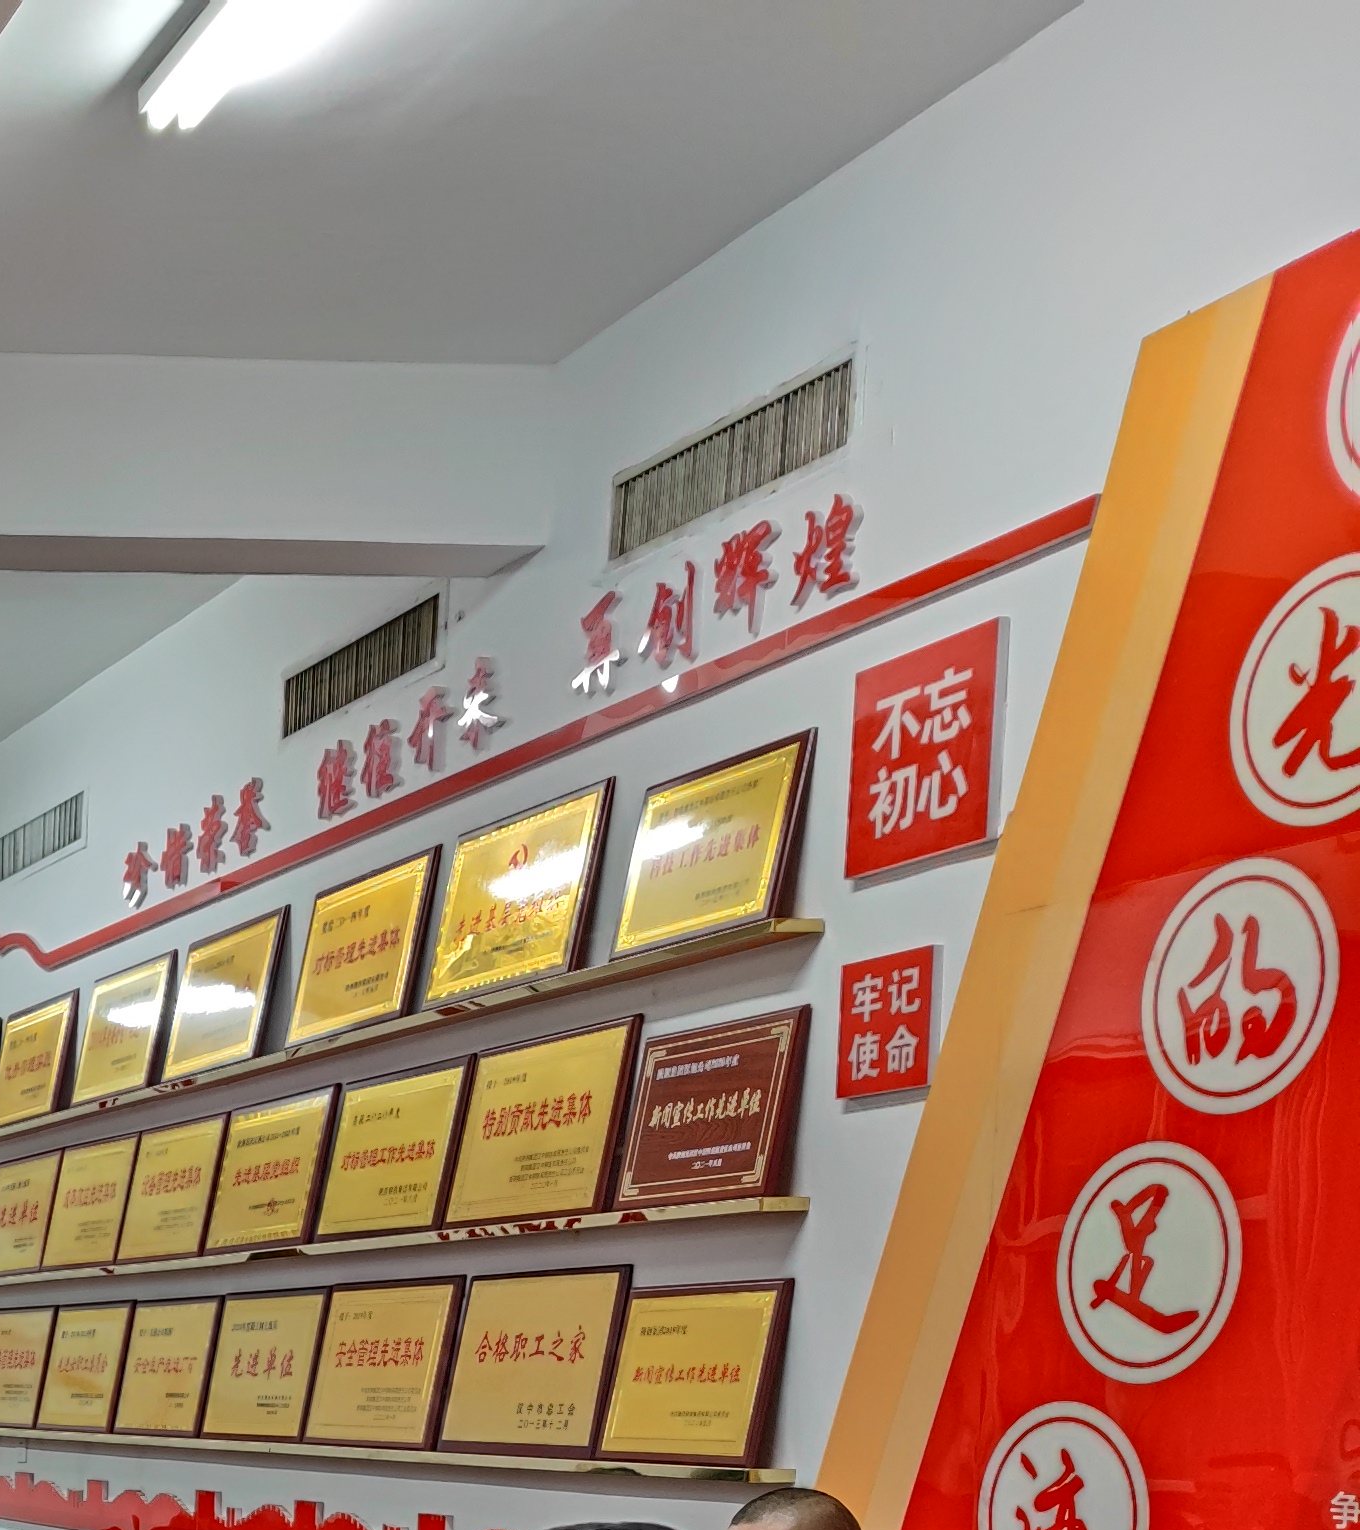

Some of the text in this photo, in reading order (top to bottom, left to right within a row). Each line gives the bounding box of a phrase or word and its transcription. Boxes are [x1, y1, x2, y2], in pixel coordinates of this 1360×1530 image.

[122, 493, 864, 907] 珍惜荣誉 继往开来 再创辉煌
[872, 666, 974, 759] 不忘
[868, 750, 968, 840] 初心
[850, 965, 922, 1023] 牢记
[847, 1025, 920, 1082] 使命
[482, 1090, 593, 1141] 特别贡献先进集体
[648, 1087, 762, 1131] 新闻宣传工作先进单位
[1090, 1182, 1200, 1335] 足
[230, 1346, 295, 1380] 先进单位
[334, 1336, 426, 1369] 安全管理先进集体
[475, 1324, 587, 1365] 合格职工之家
[632, 1363, 741, 1385] 新闻宣传工作先进单位
